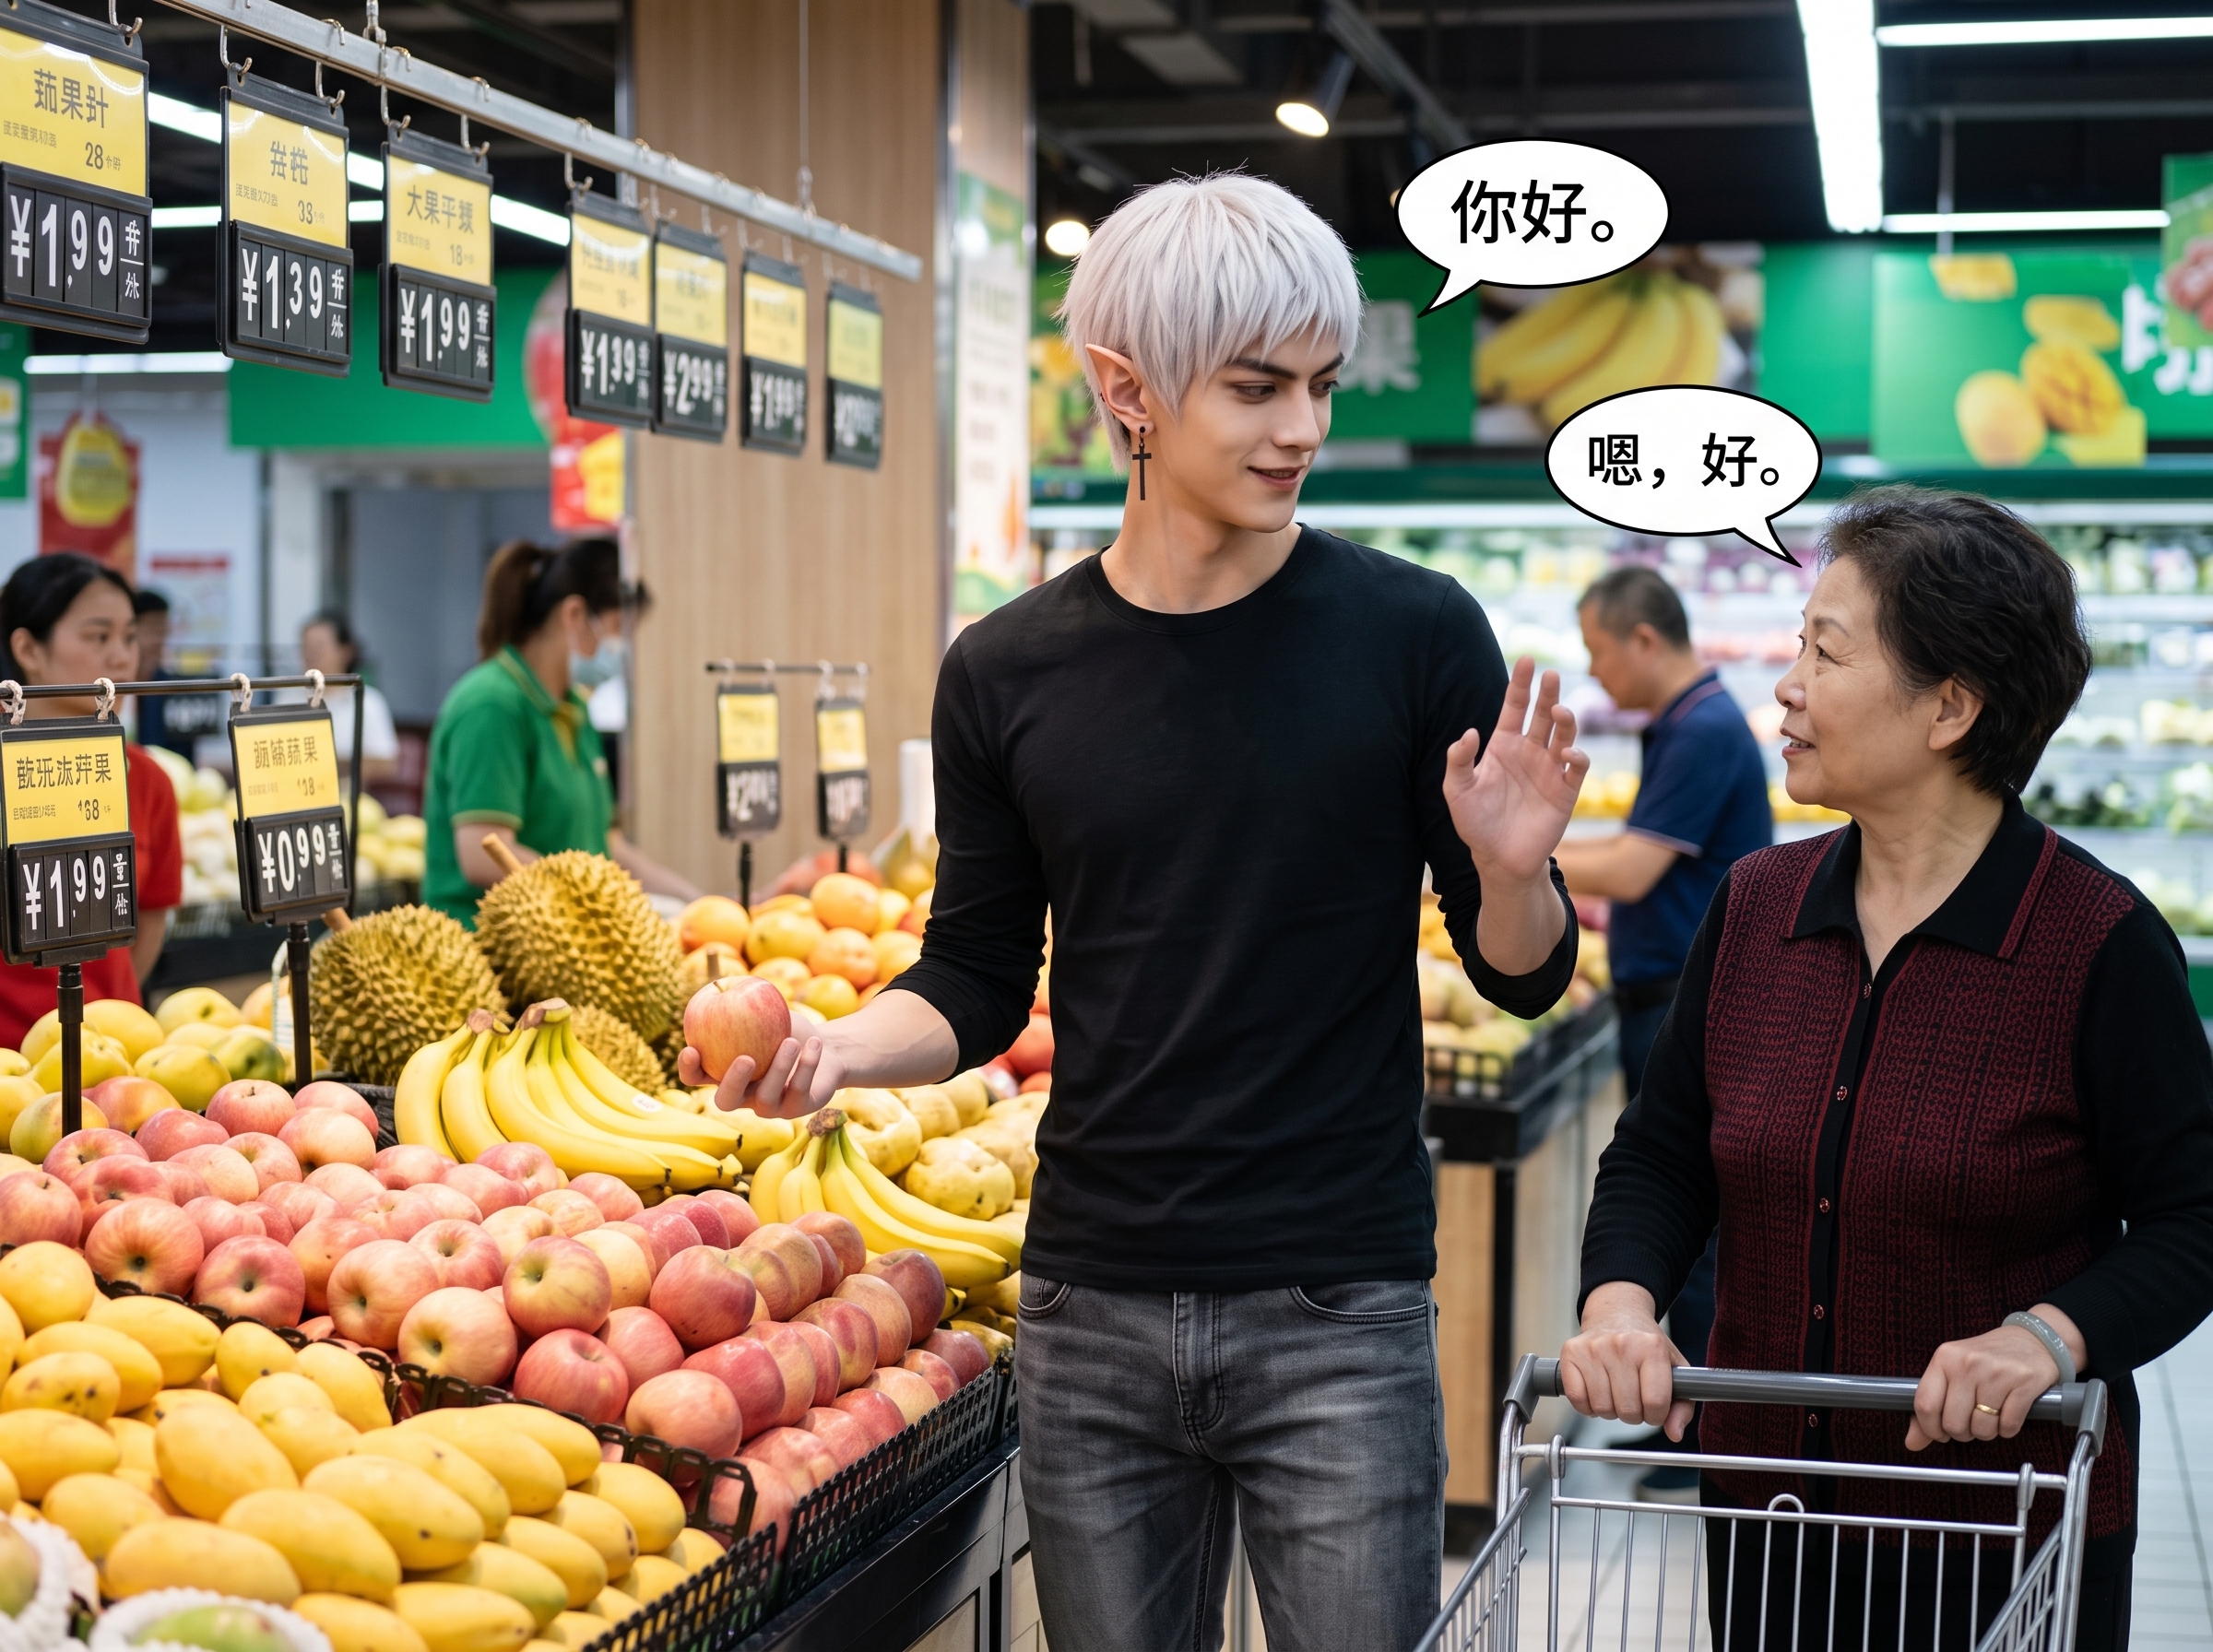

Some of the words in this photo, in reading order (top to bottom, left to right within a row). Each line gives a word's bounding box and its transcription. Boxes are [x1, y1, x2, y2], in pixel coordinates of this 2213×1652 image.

[85, 141, 103, 170] 28
[242, 248, 323, 330] ¥1.39
[22, 856, 106, 930] ¥1.99
[257, 824, 325, 893] ¥0.99
